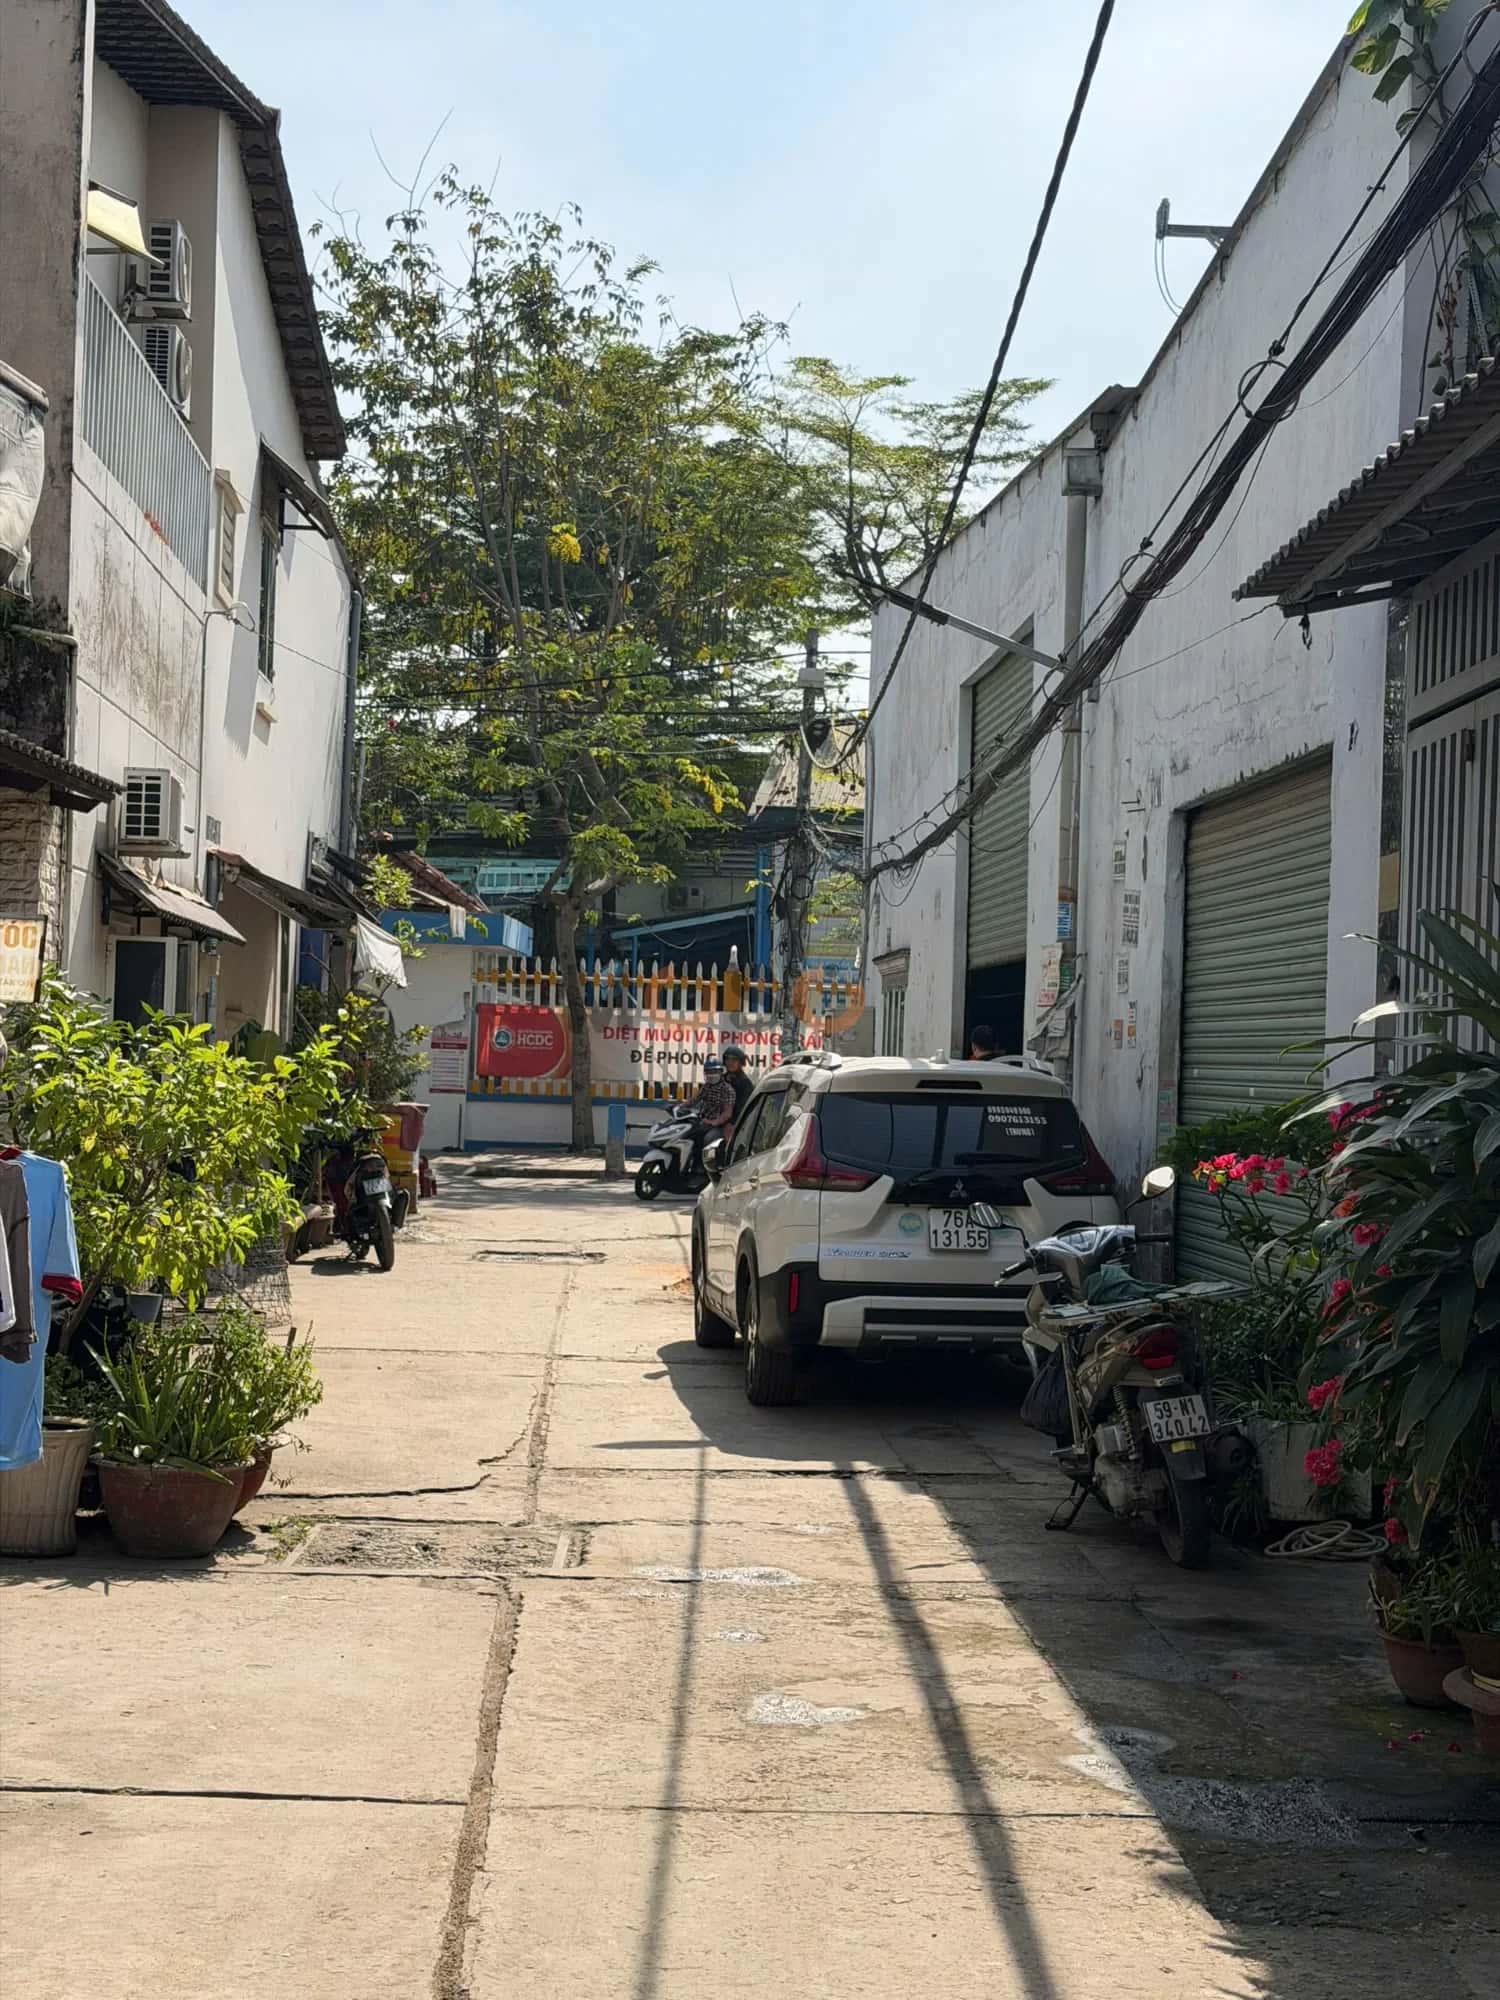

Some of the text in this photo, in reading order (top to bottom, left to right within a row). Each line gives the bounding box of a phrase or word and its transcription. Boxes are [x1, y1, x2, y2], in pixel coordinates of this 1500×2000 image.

[517, 1033, 553, 1046] HCDC
[603, 1024, 640, 1044] DIỆT
[695, 1027, 715, 1043] VÀ
[721, 1029, 781, 1046] PHÒNG
[943, 1210, 974, 1229] 76A
[932, 1229, 988, 1248] 131.55
[1154, 1415, 1209, 1440] 340.42
